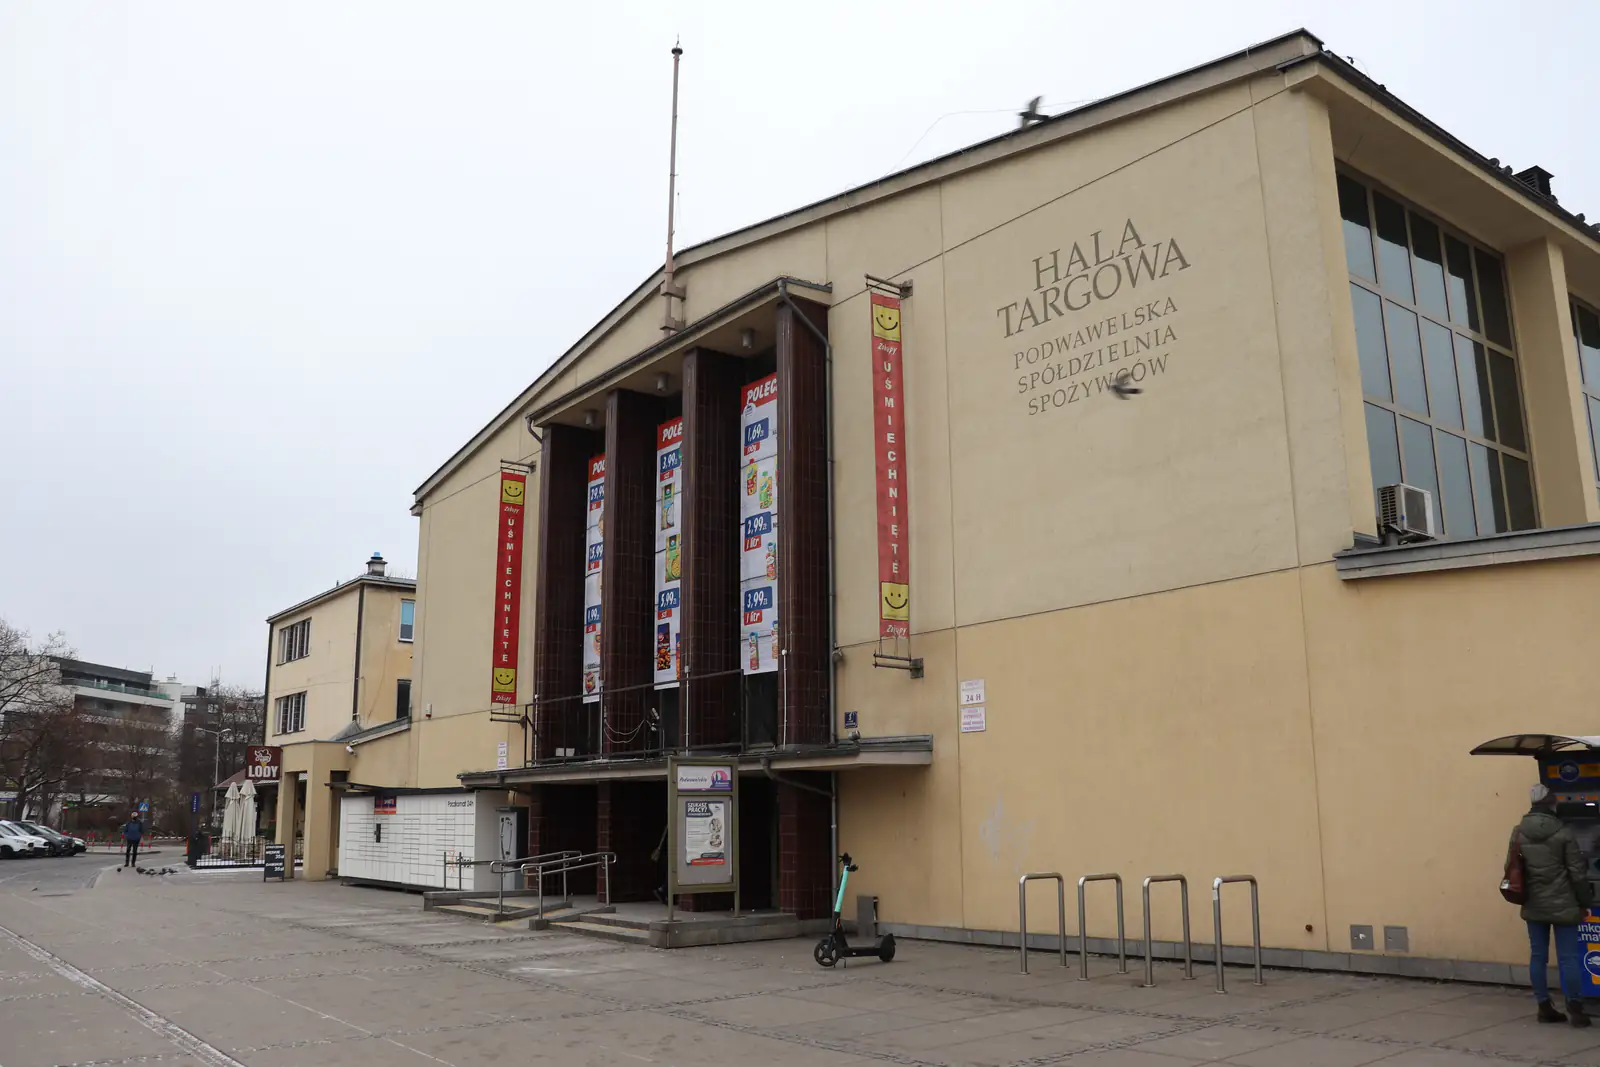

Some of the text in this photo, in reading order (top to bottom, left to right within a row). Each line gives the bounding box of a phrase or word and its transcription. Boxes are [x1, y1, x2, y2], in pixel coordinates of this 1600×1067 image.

[997, 237, 1191, 338] TARGOWA
[1032, 218, 1146, 291] HALA
[1014, 296, 1178, 370] PODWAWELSKA
[1018, 325, 1178, 393] SPÓŁDZIELNIA
[746, 378, 777, 405] POLEC
[1028, 353, 1169, 416] SPOŻYWCÓW
[248, 765, 279, 778] LODY
